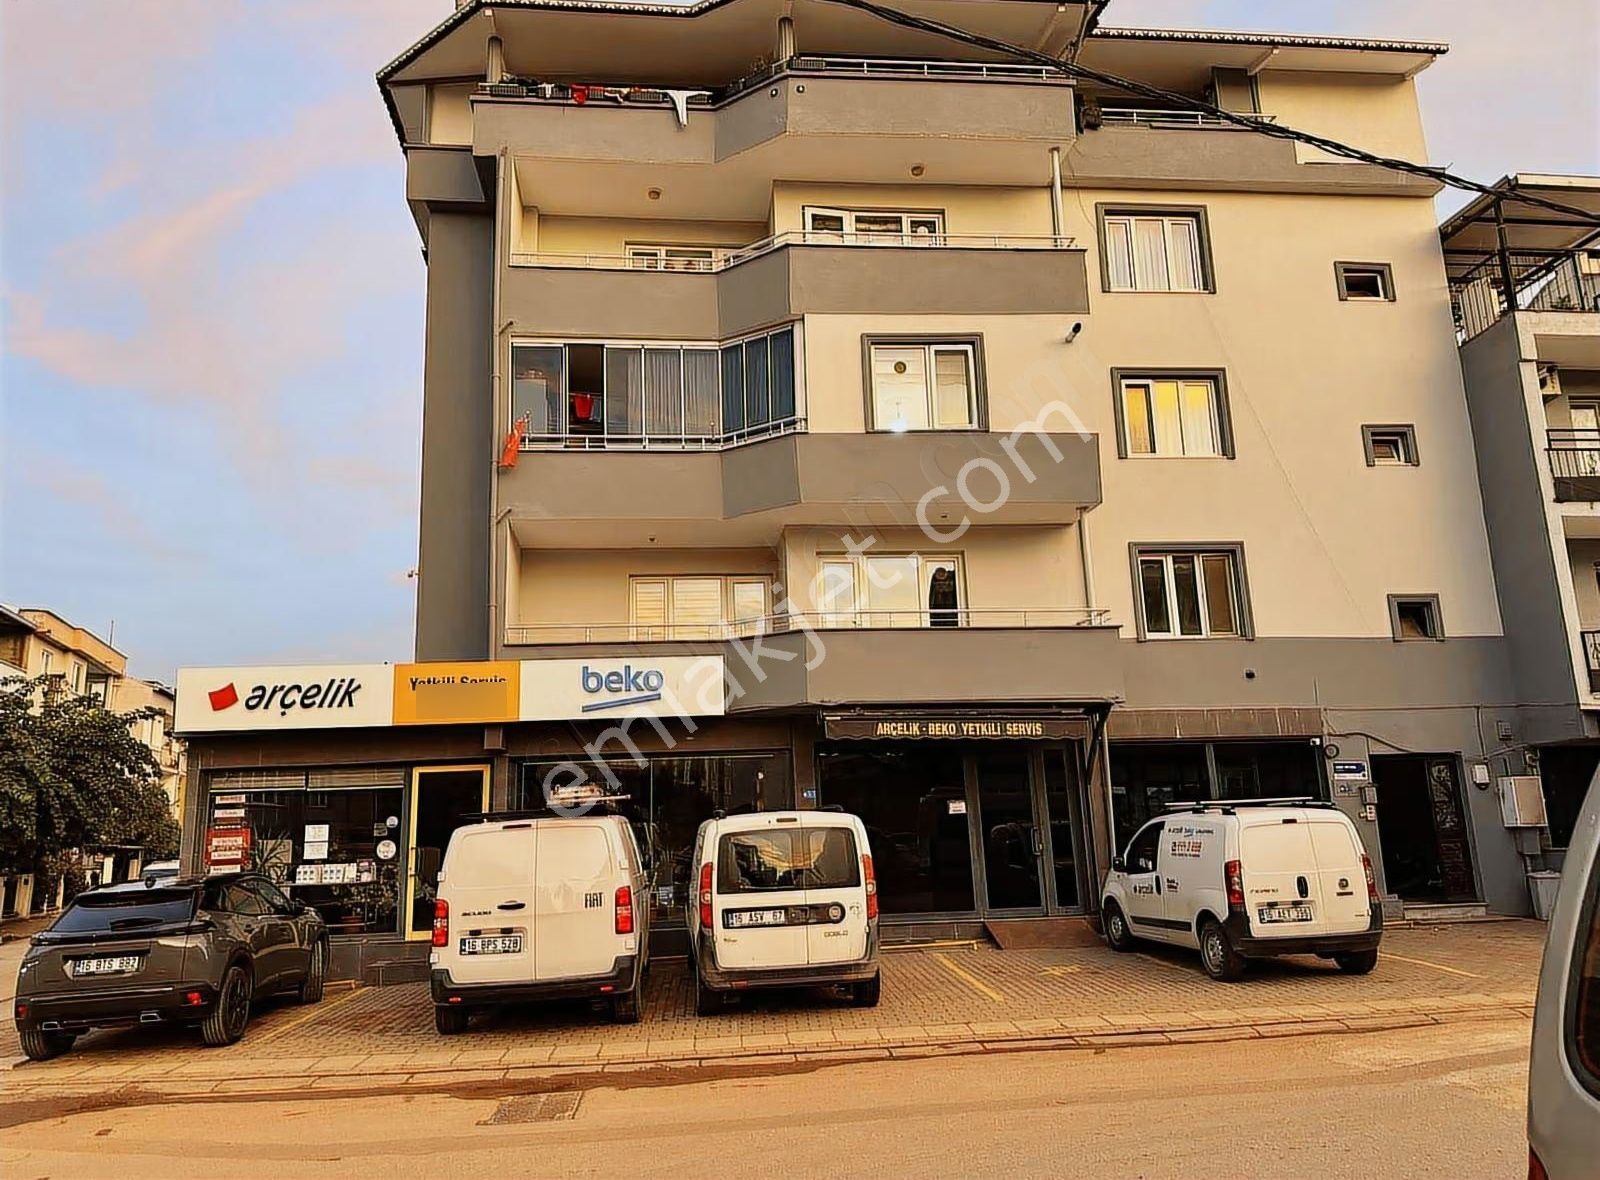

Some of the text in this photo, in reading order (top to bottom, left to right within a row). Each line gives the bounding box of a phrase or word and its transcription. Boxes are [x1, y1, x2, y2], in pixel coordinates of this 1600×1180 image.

[582, 665, 664, 693] beko
[244, 678, 362, 717] arçelik
[928, 722, 956, 735] BEKO
[584, 892, 604, 908] FIAT
